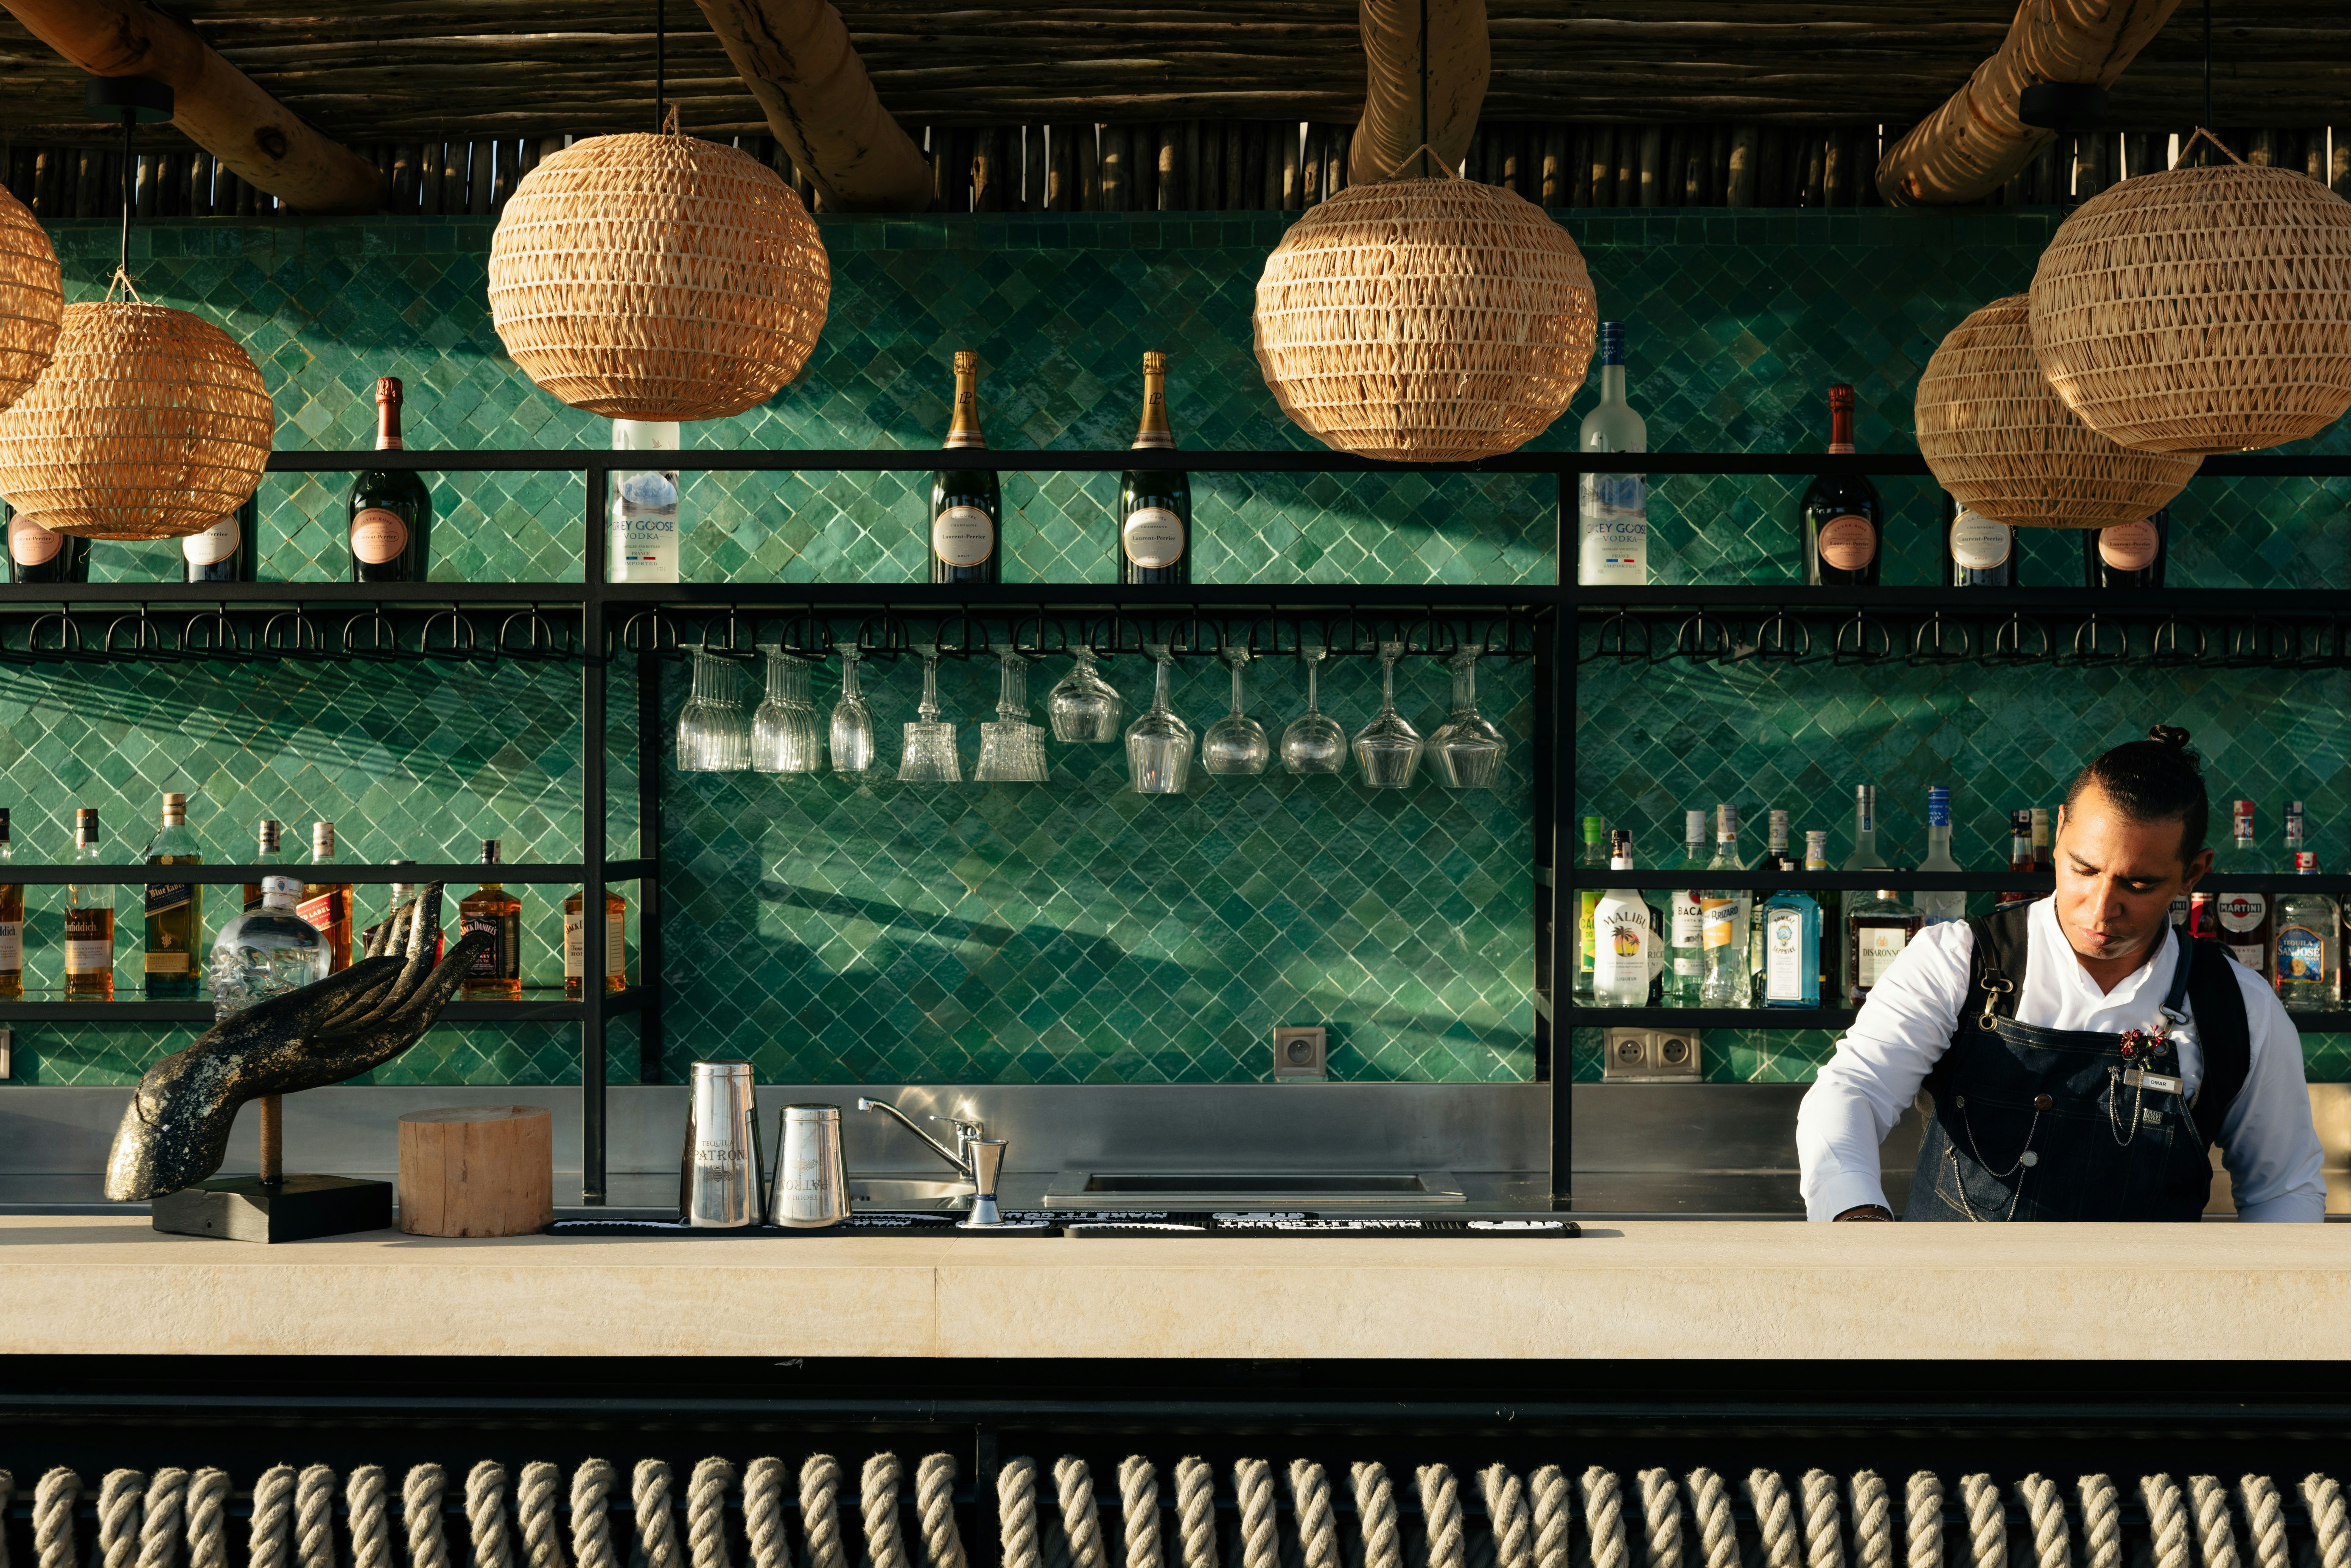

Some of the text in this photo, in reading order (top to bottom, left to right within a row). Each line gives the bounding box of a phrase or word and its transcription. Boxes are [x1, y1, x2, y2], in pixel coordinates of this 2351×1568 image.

[361, 517, 393, 525] CUVÉE ROSÉ
[613, 521, 673, 531] GREY GOOSE
[1616, 523, 1646, 534] GOOSE
[148, 888, 166, 899] Blue
[309, 906, 330, 918] LABEL
[1678, 907, 1702, 915] BACA
[2220, 904, 2261, 912] MARTINI
[1603, 911, 1648, 929] MALIBU
[1712, 906, 1738, 923] BRIZARD
[1774, 916, 1795, 925] BOMBAY
[461, 921, 497, 935] JACK DANIEL'S
[566, 923, 579, 934] JACK
[1772, 945, 1796, 954] SAPPHIRE
[694, 1148, 745, 1160] PATRÓN
